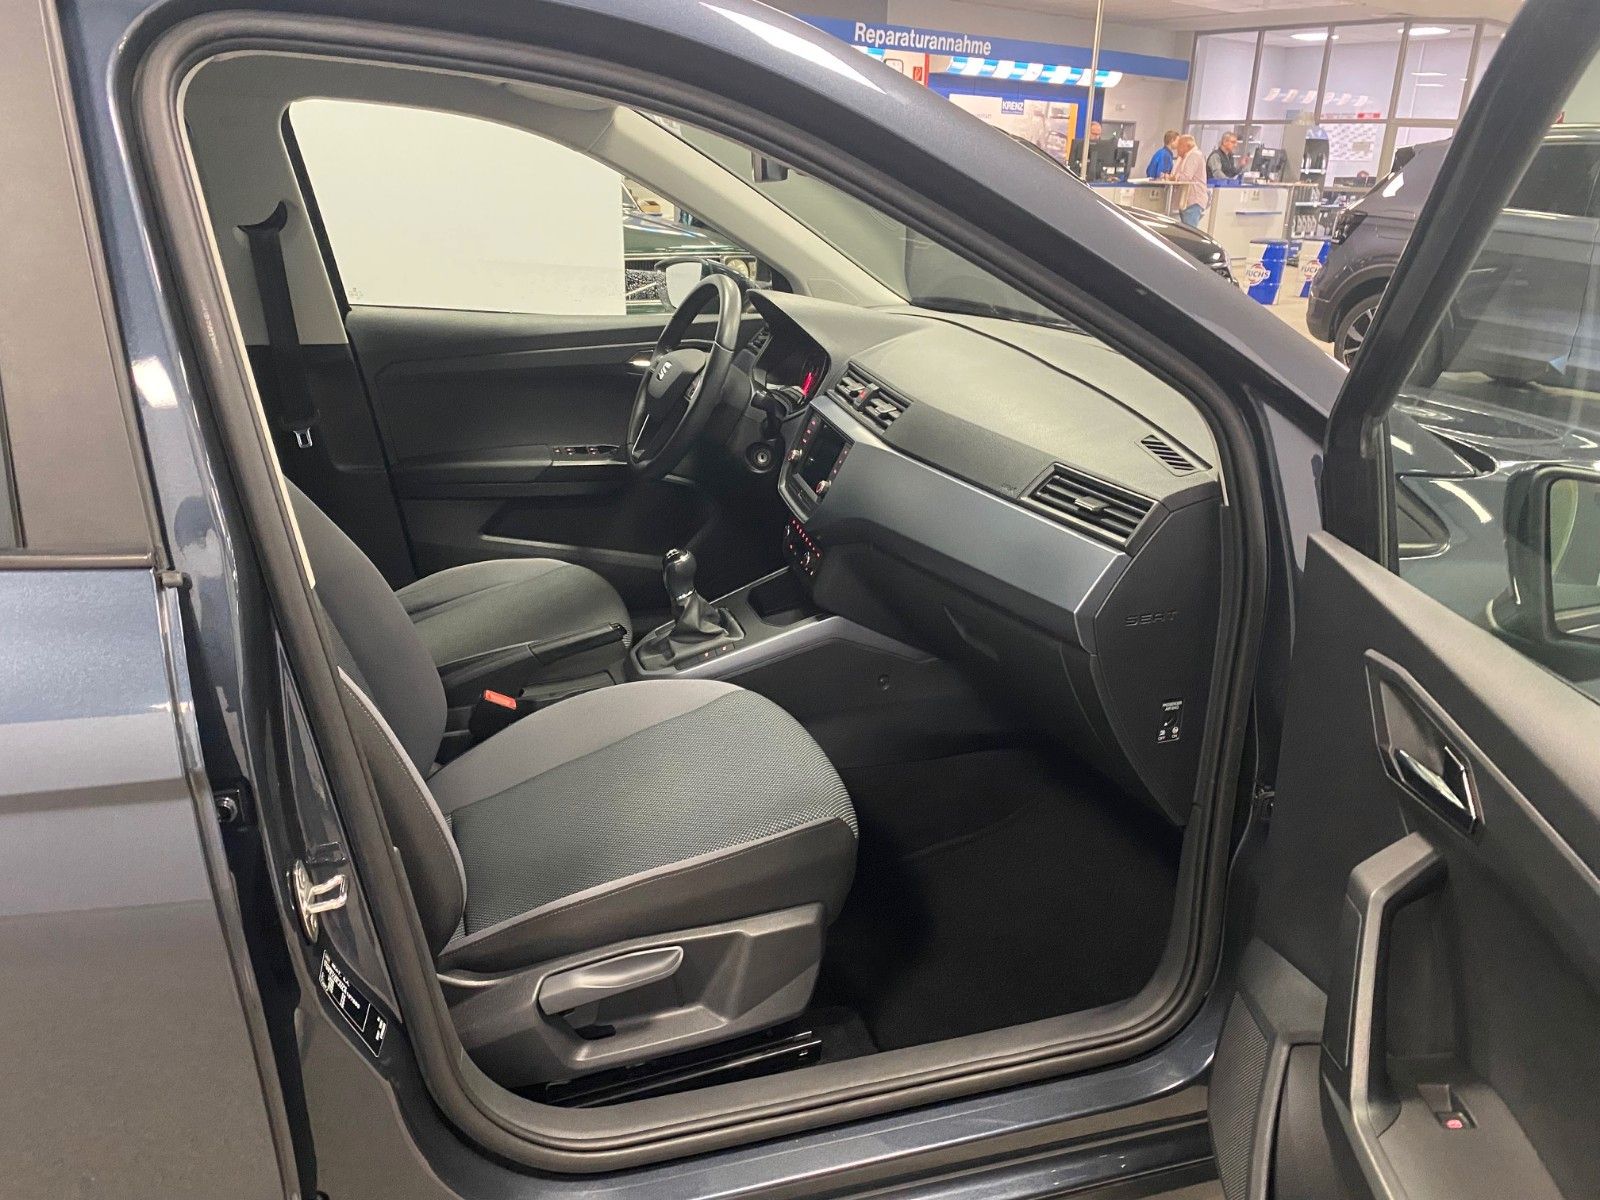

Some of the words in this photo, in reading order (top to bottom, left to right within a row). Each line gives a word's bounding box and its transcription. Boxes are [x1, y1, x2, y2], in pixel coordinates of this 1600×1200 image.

[854, 21, 992, 55] Reparaturannahme
[1002, 101, 1024, 111] KRENZ
[1246, 268, 1270, 278] FUCHS
[1302, 263, 1319, 273] FUCH
[1124, 609, 1178, 626] SEAT
